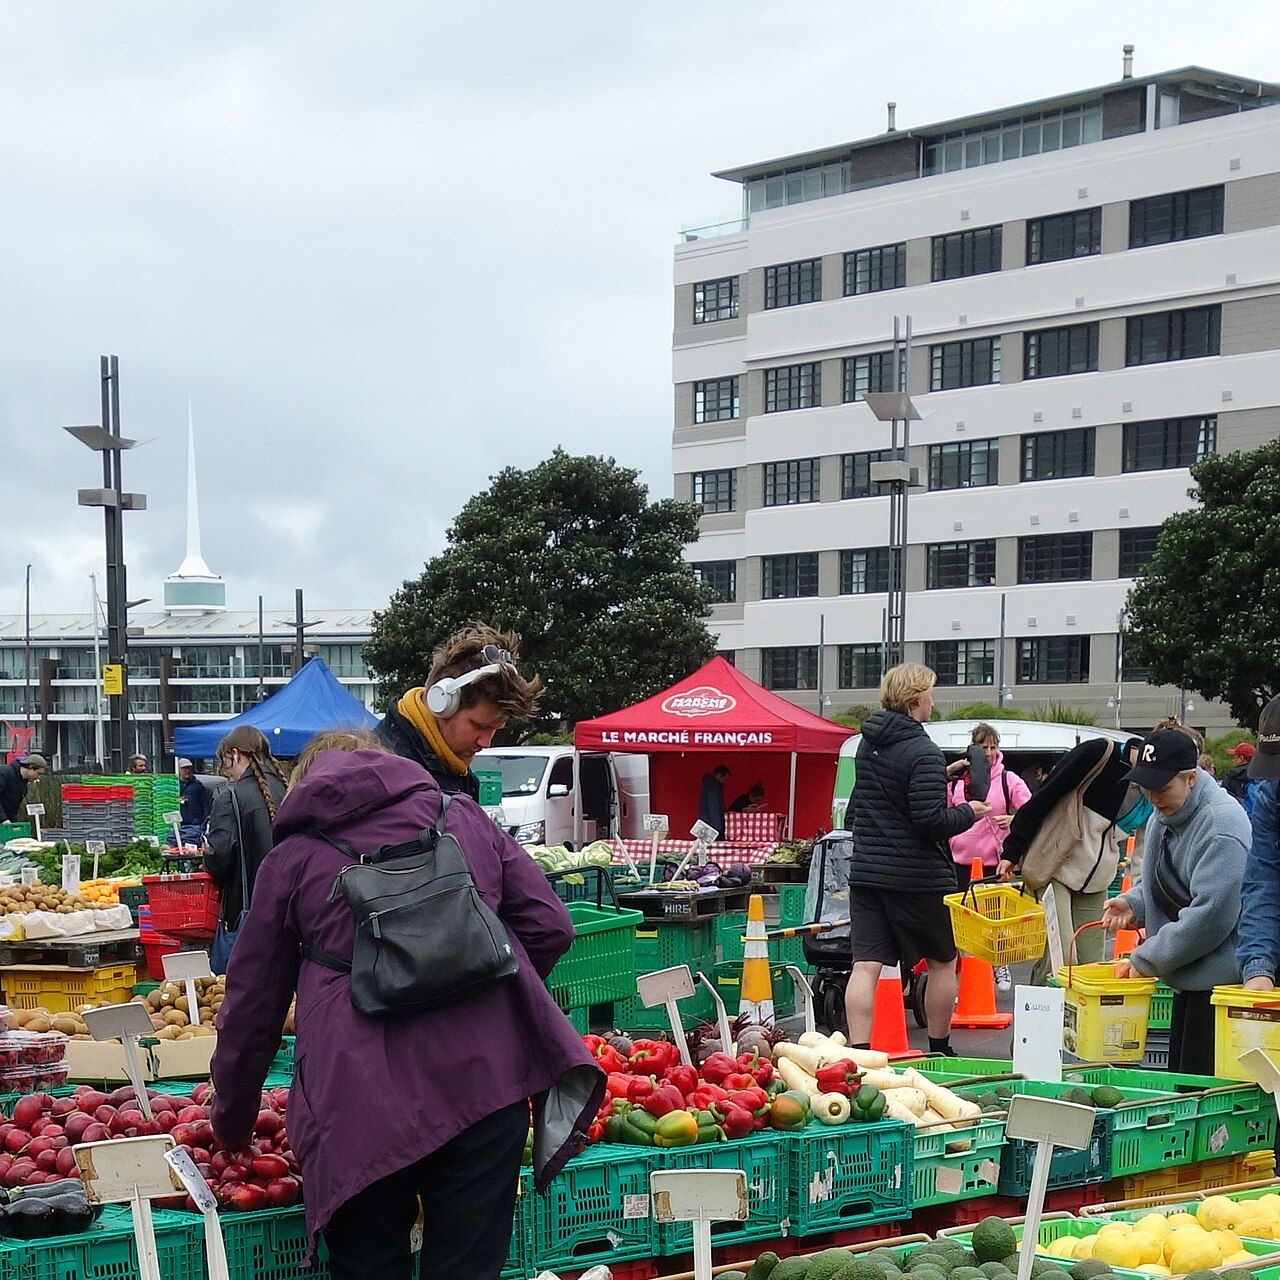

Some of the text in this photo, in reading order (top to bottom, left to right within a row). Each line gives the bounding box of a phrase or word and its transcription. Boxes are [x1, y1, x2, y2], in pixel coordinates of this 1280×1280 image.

[602, 730, 772, 746] LE MARCHÉ FRANÇAIS
[664, 904, 689, 914] HIRE
